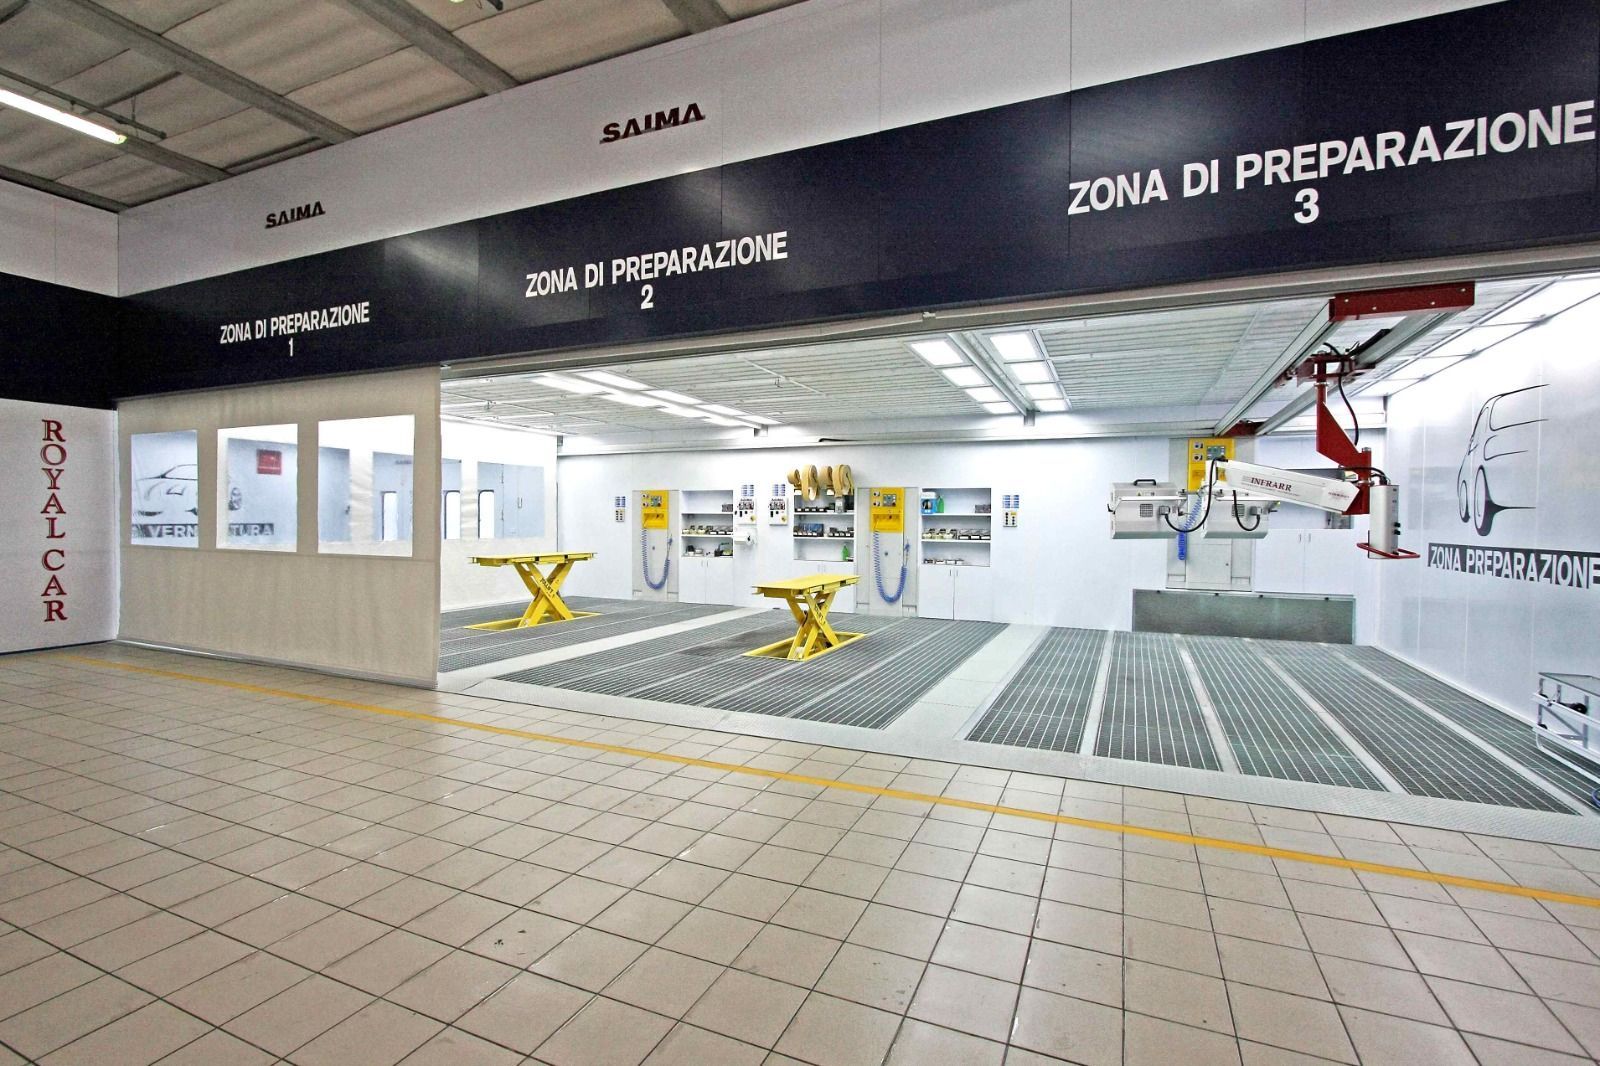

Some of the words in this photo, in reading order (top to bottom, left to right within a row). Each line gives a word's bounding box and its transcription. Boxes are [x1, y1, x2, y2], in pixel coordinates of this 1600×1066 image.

[600, 103, 705, 143] SAIMA
[1067, 168, 1168, 216] ZONA
[1183, 159, 1219, 199] DI
[1236, 100, 1597, 190] PREPARAZIONE
[265, 201, 326, 229] SAIMA
[1293, 187, 1319, 225] 3
[525, 266, 577, 298] ZONA
[585, 261, 604, 289] DI
[612, 230, 788, 285] PREPARAZIONE
[640, 283, 654, 310] 2
[220, 321, 252, 344] ZONA
[255, 318, 267, 340] DI
[270, 301, 370, 337] PREPARAZIONE
[288, 337, 294, 357] 1
[40, 418, 67, 539] ROYAL
[41, 548, 68, 622] CAR
[1430, 546, 1462, 572] ZONA
[1466, 549, 1600, 589] PREPARAZIONE
